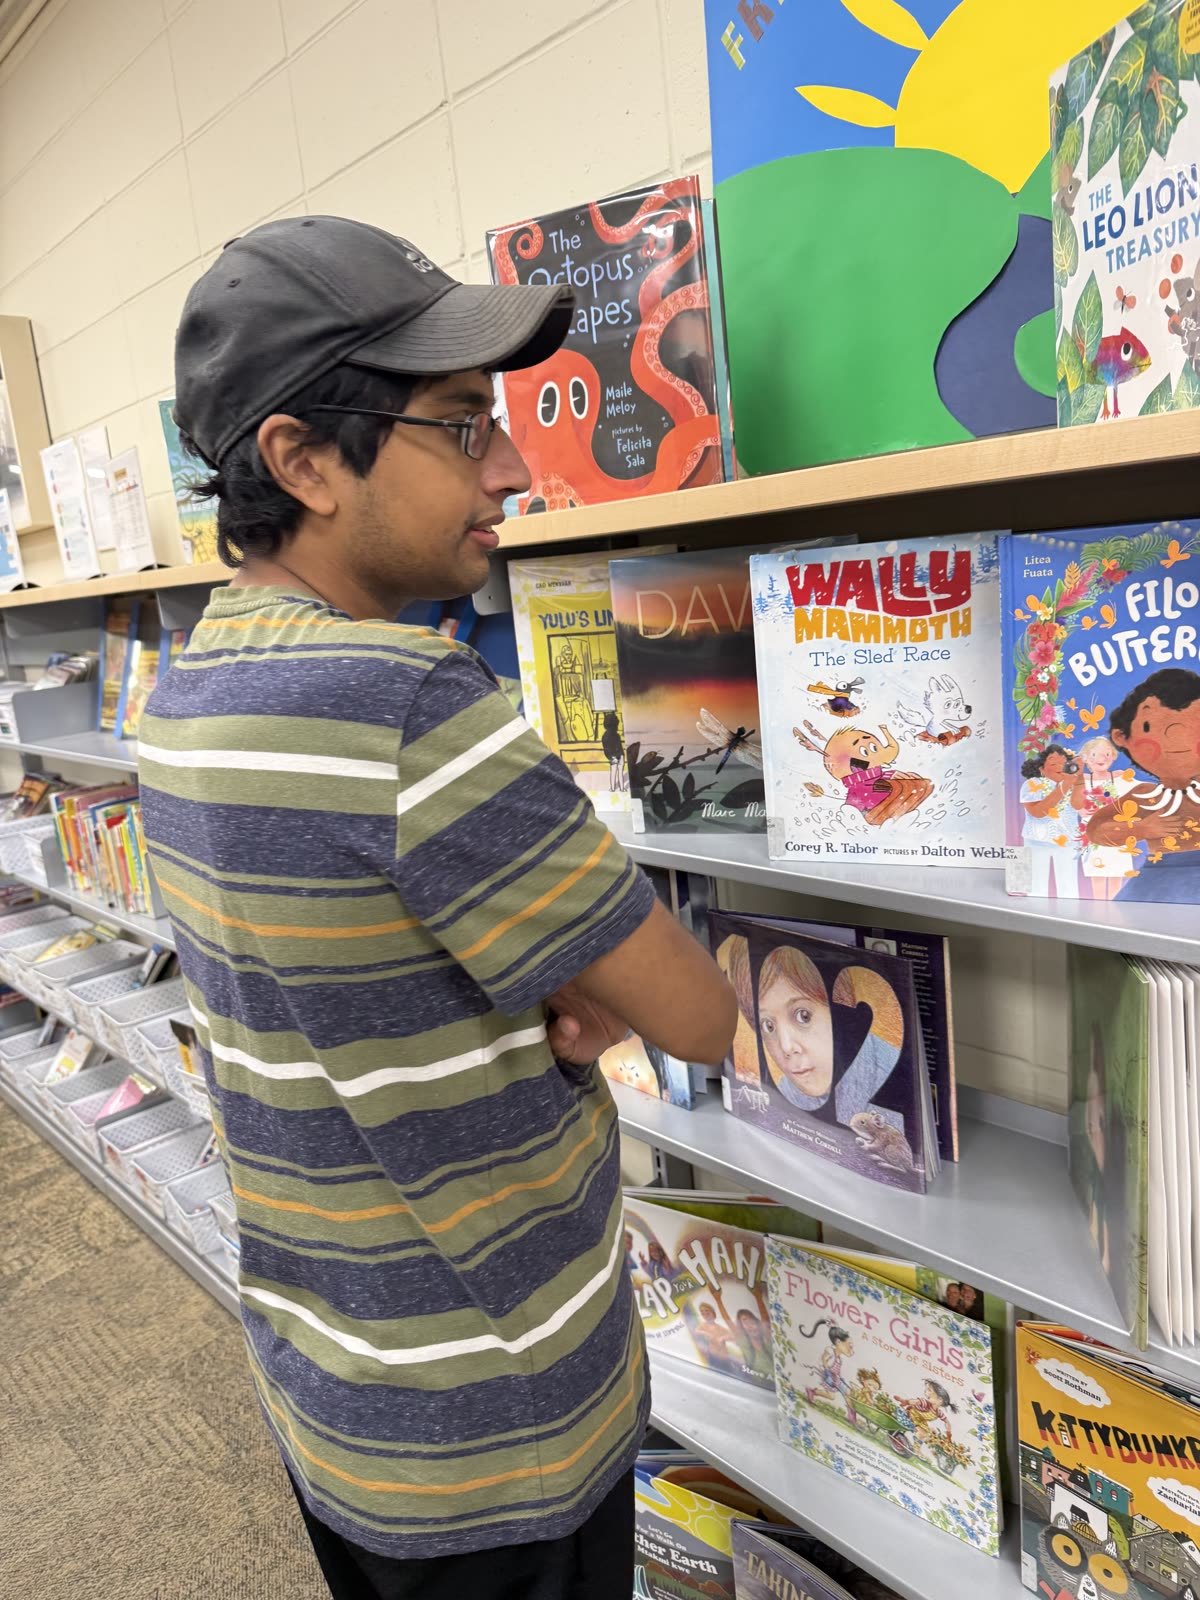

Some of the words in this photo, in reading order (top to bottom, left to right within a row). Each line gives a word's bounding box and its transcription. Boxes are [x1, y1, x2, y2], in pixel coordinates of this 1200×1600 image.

[1082, 205, 1126, 252] LEO
[1133, 163, 1198, 227] LION
[1089, 183, 1112, 212] THE
[549, 229, 581, 254] The
[1105, 207, 1200, 274] TREASURY
[568, 299, 633, 344] apes
[606, 381, 632, 401] Maile
[606, 400, 636, 418] Meloy
[612, 426, 634, 439] pictures
[636, 424, 643, 433] by
[617, 435, 652, 454] Felicita
[625, 454, 645, 469] Sala
[1023, 568, 1054, 578] Fuata
[1024, 556, 1051, 566] Litea
[786, 550, 971, 618] WALLY
[1125, 576, 1200, 622] FILO
[537, 610, 590, 631] YULU'S
[594, 608, 614, 627] LIN
[794, 607, 972, 644] MAMMOTH
[809, 651, 846, 667] The
[854, 647, 894, 665] Sled
[903, 646, 951, 662] Race
[1068, 625, 1200, 687] BUTTER
[700, 801, 736, 818] Marc
[744, 801, 767, 818] Ma
[785, 841, 821, 855] Corey
[826, 842, 838, 853] R.
[841, 842, 878, 854] Tabor
[921, 845, 965, 858] Dalton
[634, 1277, 679, 1320] LAP
[678, 1236, 764, 1291] HAN
[784, 1270, 879, 1330] Flower
[889, 1317, 964, 1370] Girls
[861, 1333, 869, 1341] A
[906, 1355, 919, 1365] of
[1043, 1368, 1063, 1383] Scott
[1064, 1379, 1102, 1402] Rothman
[1056, 1368, 1080, 1383] WRITTEN
[634, 1532, 667, 1556] ther
[669, 1548, 719, 1575] Earth
[744, 1549, 816, 1600] TAKIN
